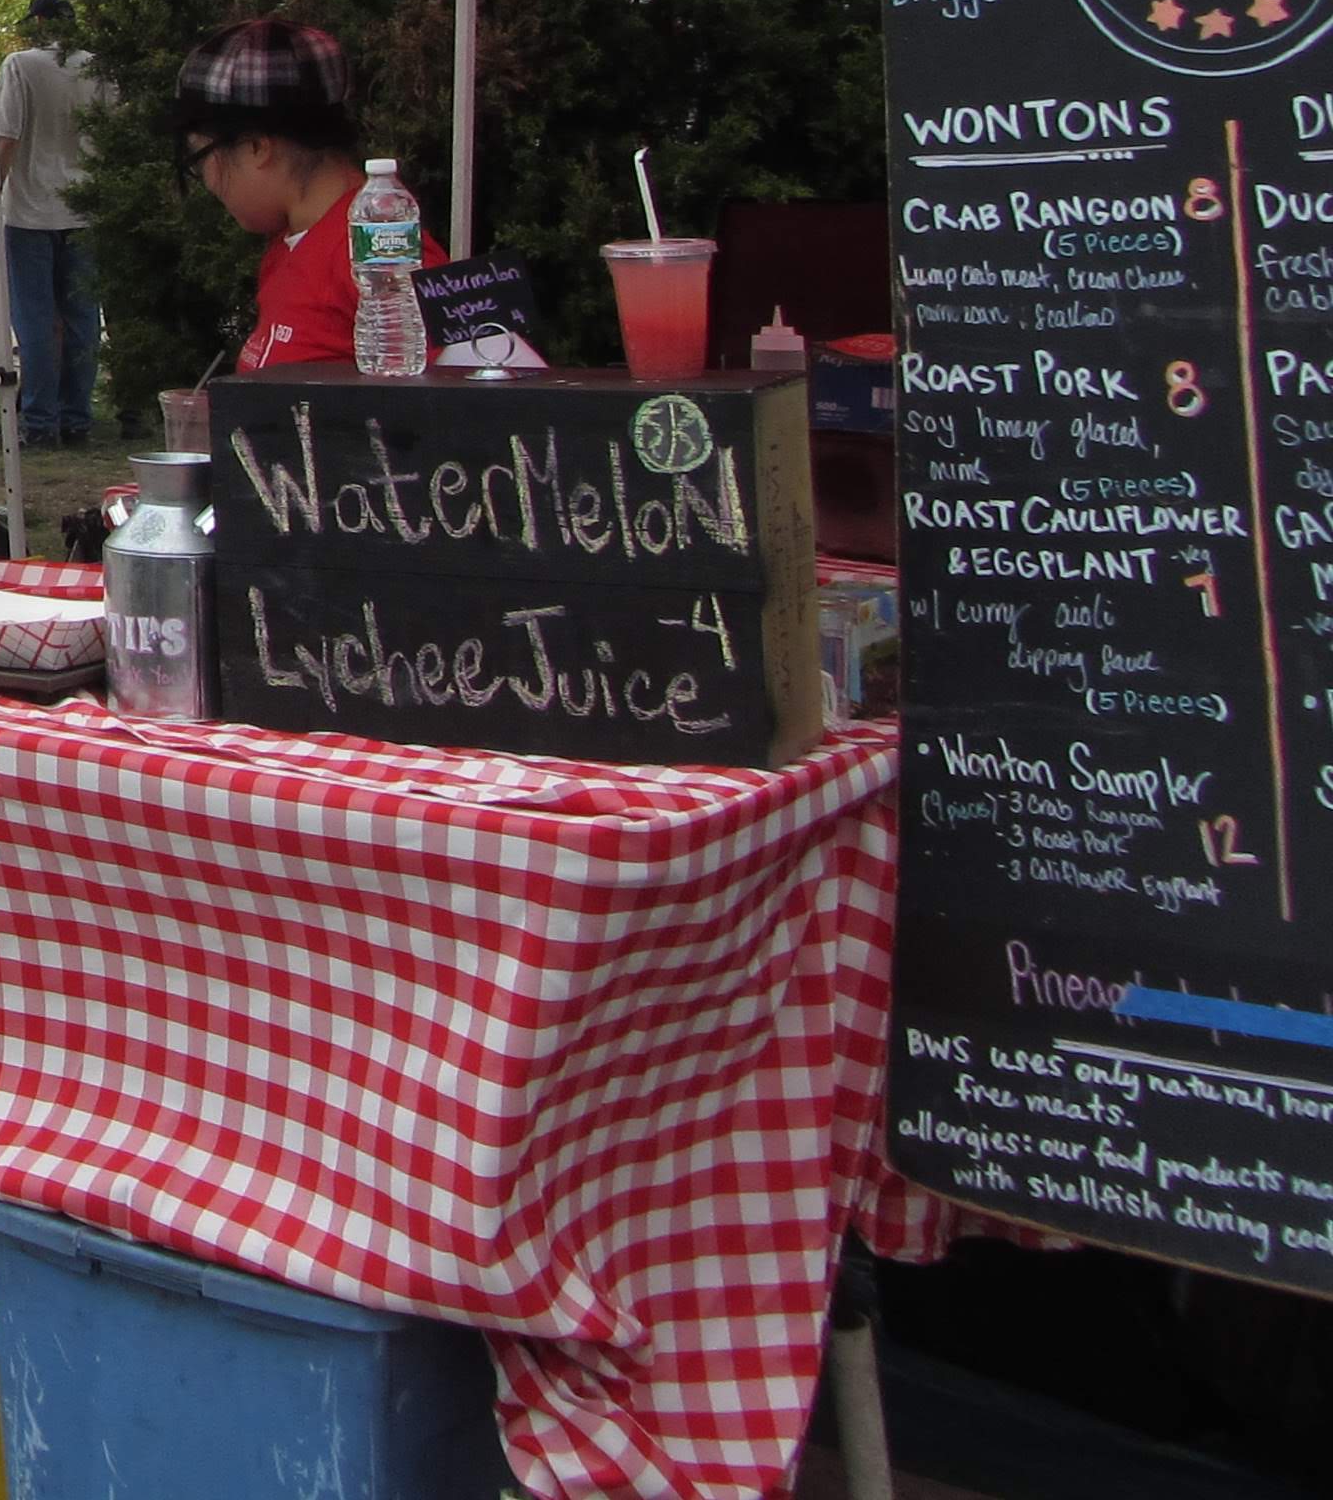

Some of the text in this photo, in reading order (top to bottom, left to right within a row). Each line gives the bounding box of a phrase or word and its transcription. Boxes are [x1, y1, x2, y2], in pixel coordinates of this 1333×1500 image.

[903, 96, 1172, 147] WONTONS
[902, 177, 1223, 234] CRAB RANGOON 8
[416, 261, 521, 299] Watermelon
[442, 298, 525, 324] Lychee 4
[901, 350, 1208, 417] ROAST PORK 8
[904, 410, 955, 448] soy
[904, 492, 1248, 539] ROAST CAULIFLOWER
[972, 547, 1156, 584] EGGPLANT
[1183, 572, 1221, 618] 7
[938, 734, 1261, 868] Wonton Sampler 12
[906, 1028, 1277, 1119] BWS uses only natural,
[954, 1073, 1020, 1108] free
[898, 1110, 1033, 1161] allergies:
[1039, 1137, 1088, 1162] our
[1092, 1135, 1148, 1177] food
[1156, 1156, 1285, 1192] products
[952, 1161, 1017, 1192] with
[1027, 1173, 1167, 1221] shellfish
[1174, 1196, 1270, 1263] during
